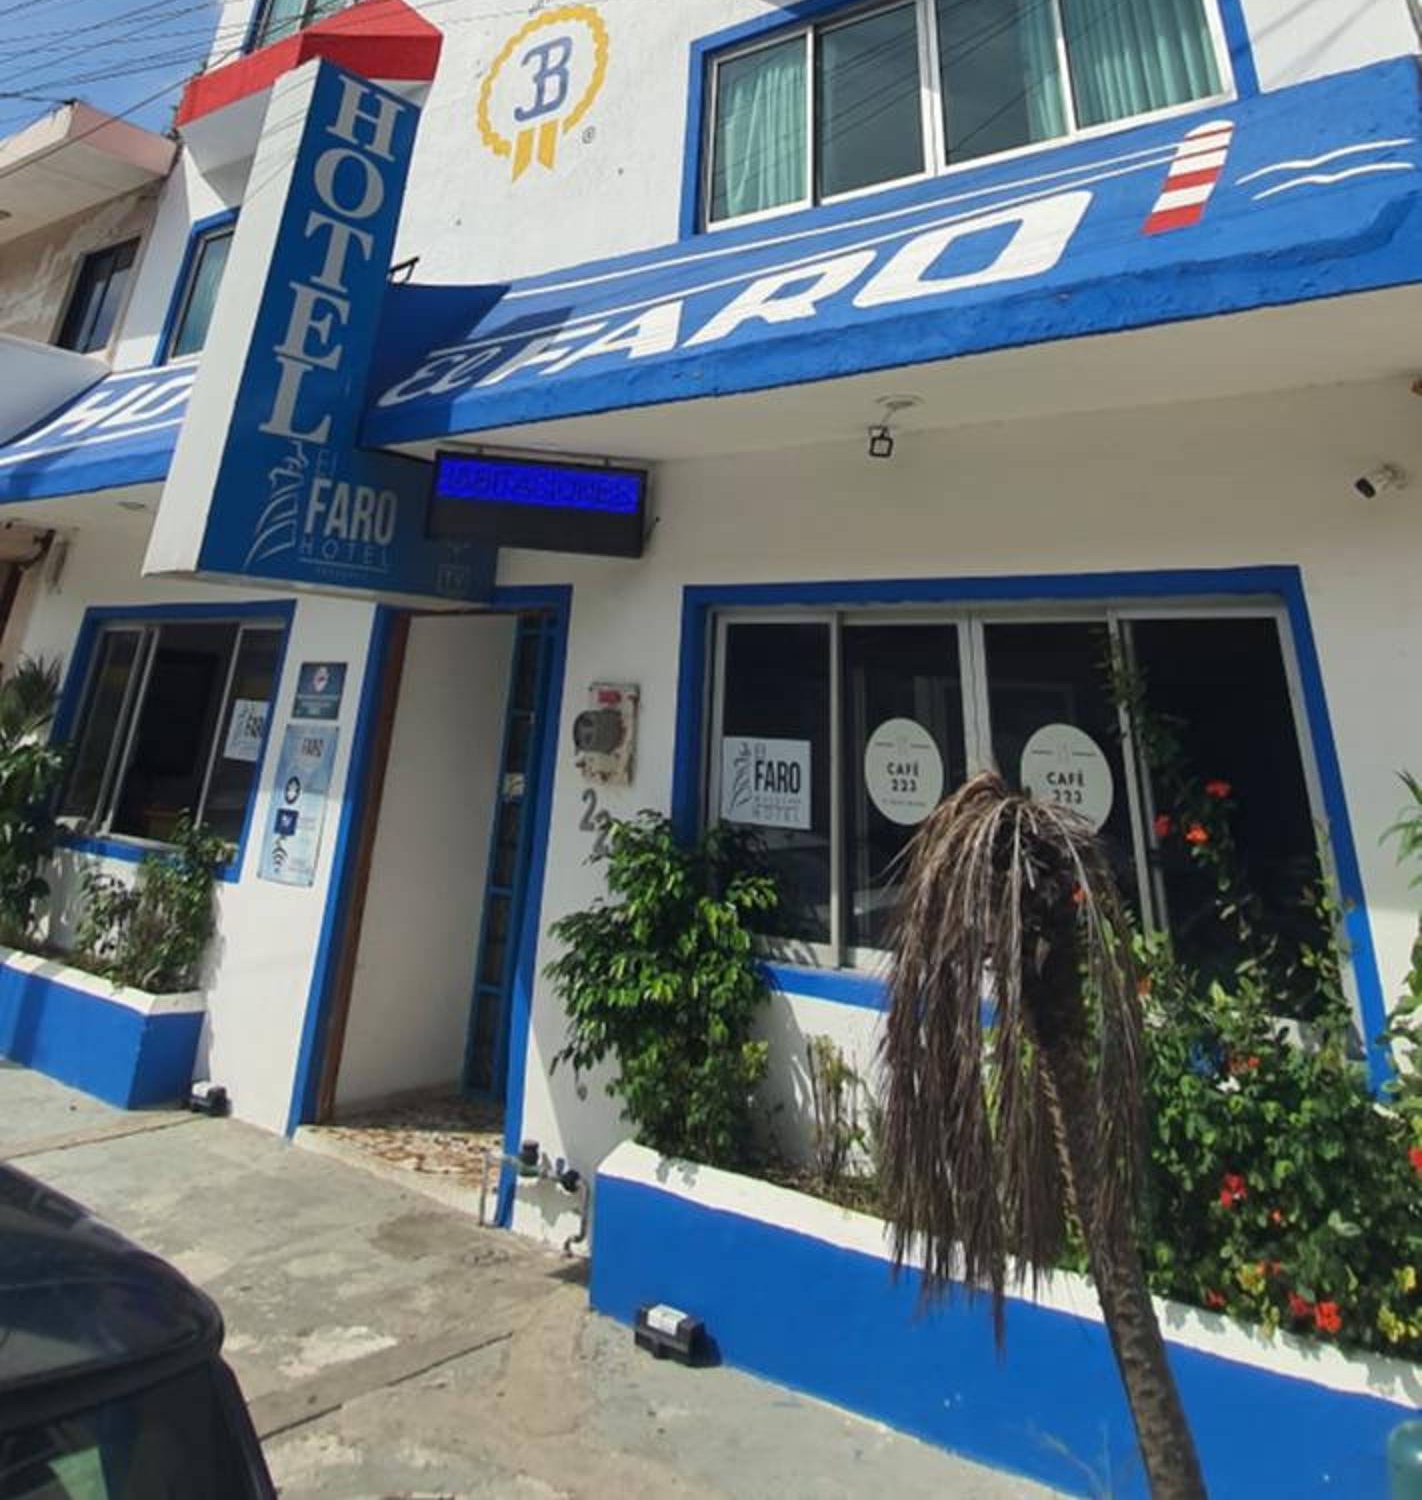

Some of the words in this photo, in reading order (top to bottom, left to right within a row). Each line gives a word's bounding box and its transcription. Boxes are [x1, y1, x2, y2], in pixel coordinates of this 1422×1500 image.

[258, 73, 407, 445] HOTEL
[472, 190, 1094, 388] FARO
[303, 476, 399, 547] FARO
[298, 533, 392, 566] HOTEL
[754, 760, 801, 794] FARO
[1046, 768, 1085, 787] CAFÉ
